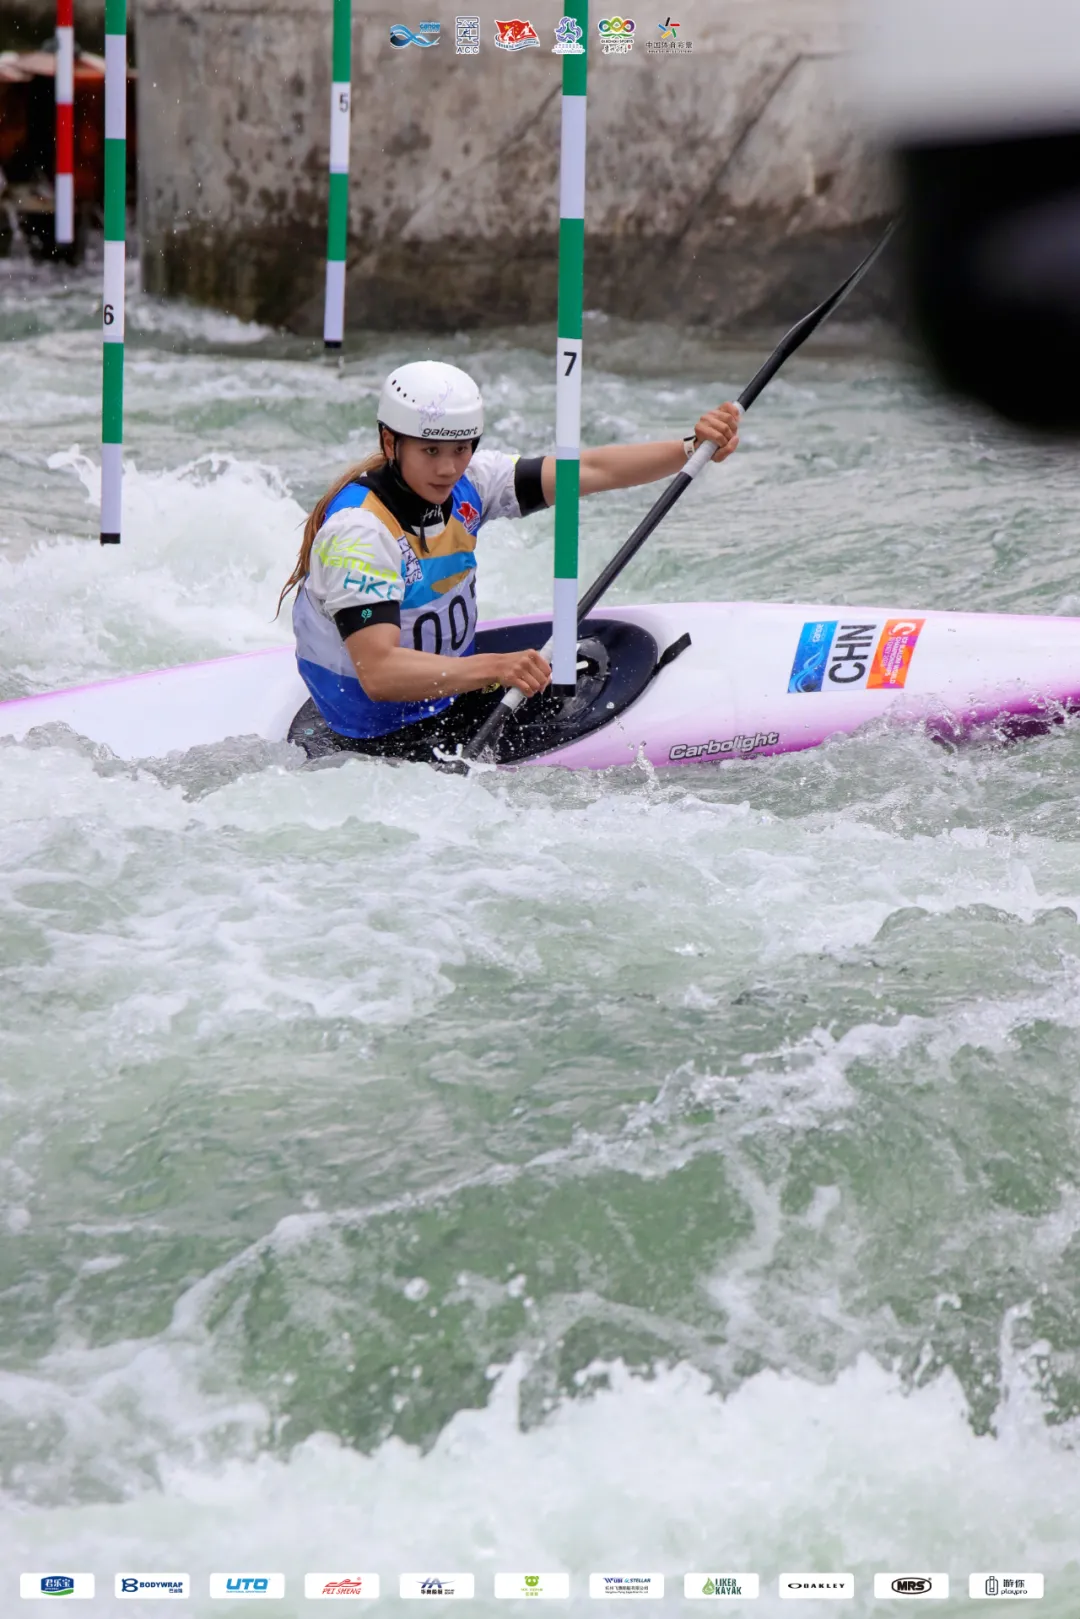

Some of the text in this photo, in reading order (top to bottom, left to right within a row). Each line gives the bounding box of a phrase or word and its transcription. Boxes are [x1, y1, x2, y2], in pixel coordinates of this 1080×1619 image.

[340, 92, 348, 113] 5
[104, 304, 114, 325] 6
[564, 351, 577, 376] 7
[422, 427, 478, 438] galasport
[828, 624, 877, 683] CHN
[669, 732, 779, 760] Carbolight
